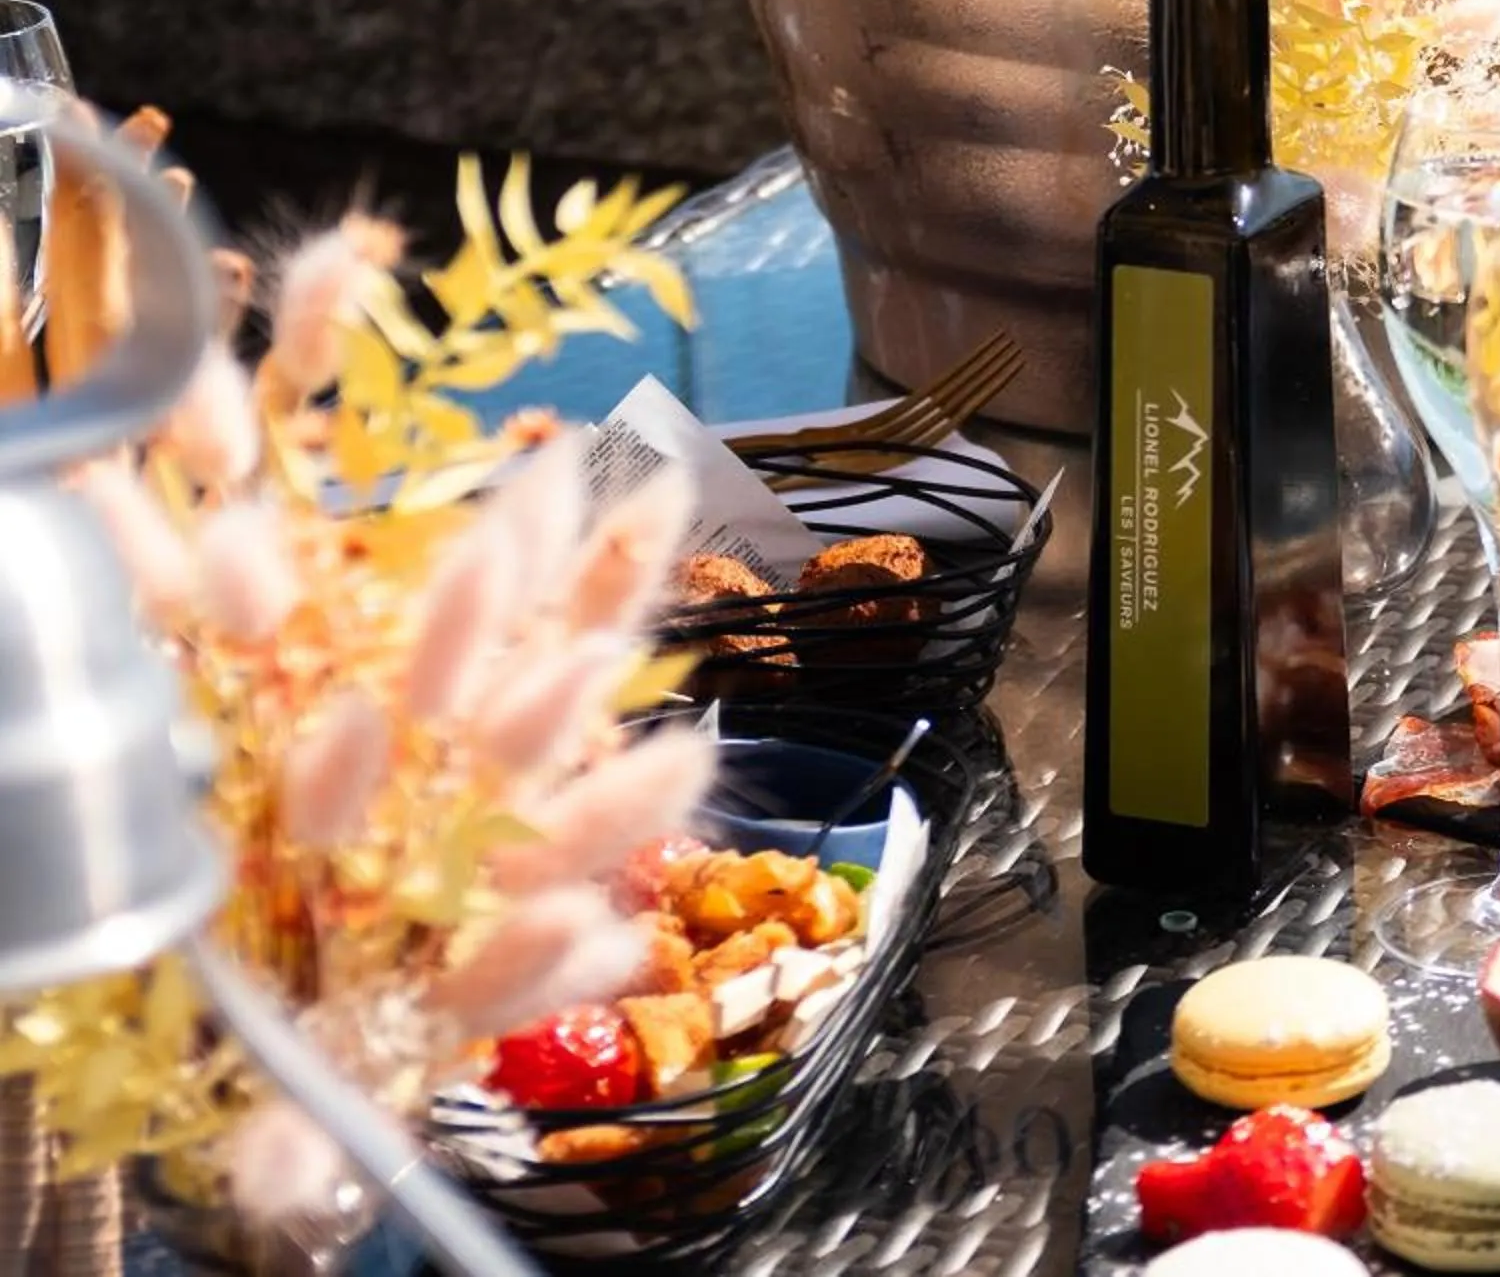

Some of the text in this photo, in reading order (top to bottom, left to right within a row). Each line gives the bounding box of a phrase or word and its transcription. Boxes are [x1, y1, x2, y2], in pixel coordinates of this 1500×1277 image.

[1119, 495, 1134, 630] LES SAVEURS
[1142, 403, 1160, 612] LIONEL RODRIGUEZ
